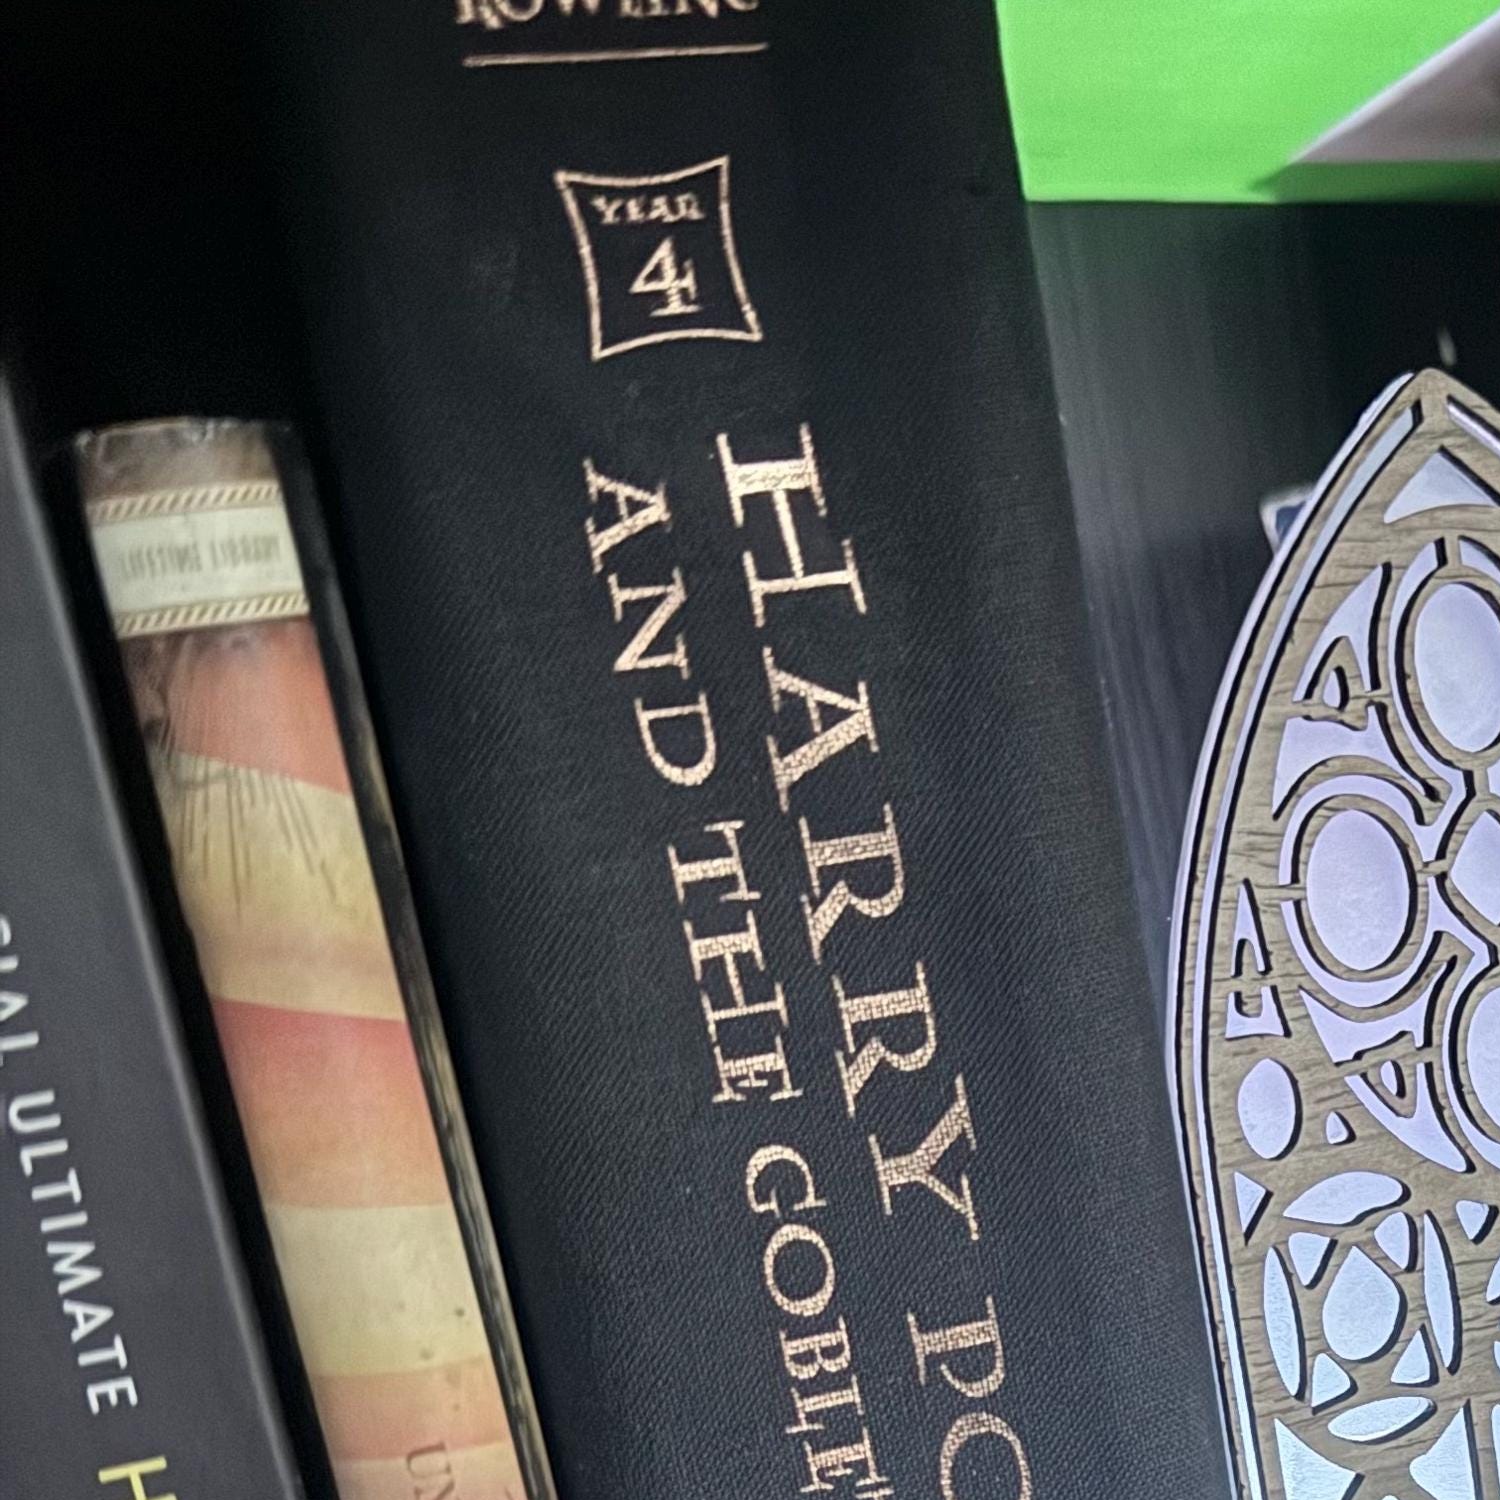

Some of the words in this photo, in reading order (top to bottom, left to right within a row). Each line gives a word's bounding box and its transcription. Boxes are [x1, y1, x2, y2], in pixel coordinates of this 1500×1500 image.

[591, 192, 705, 225] YEAR
[629, 237, 704, 318] 4
[583, 456, 719, 787] AND
[669, 820, 803, 1103] THE
[716, 422, 979, 1240] HARRY
[8, 1089, 139, 1415] ULTIMATE
